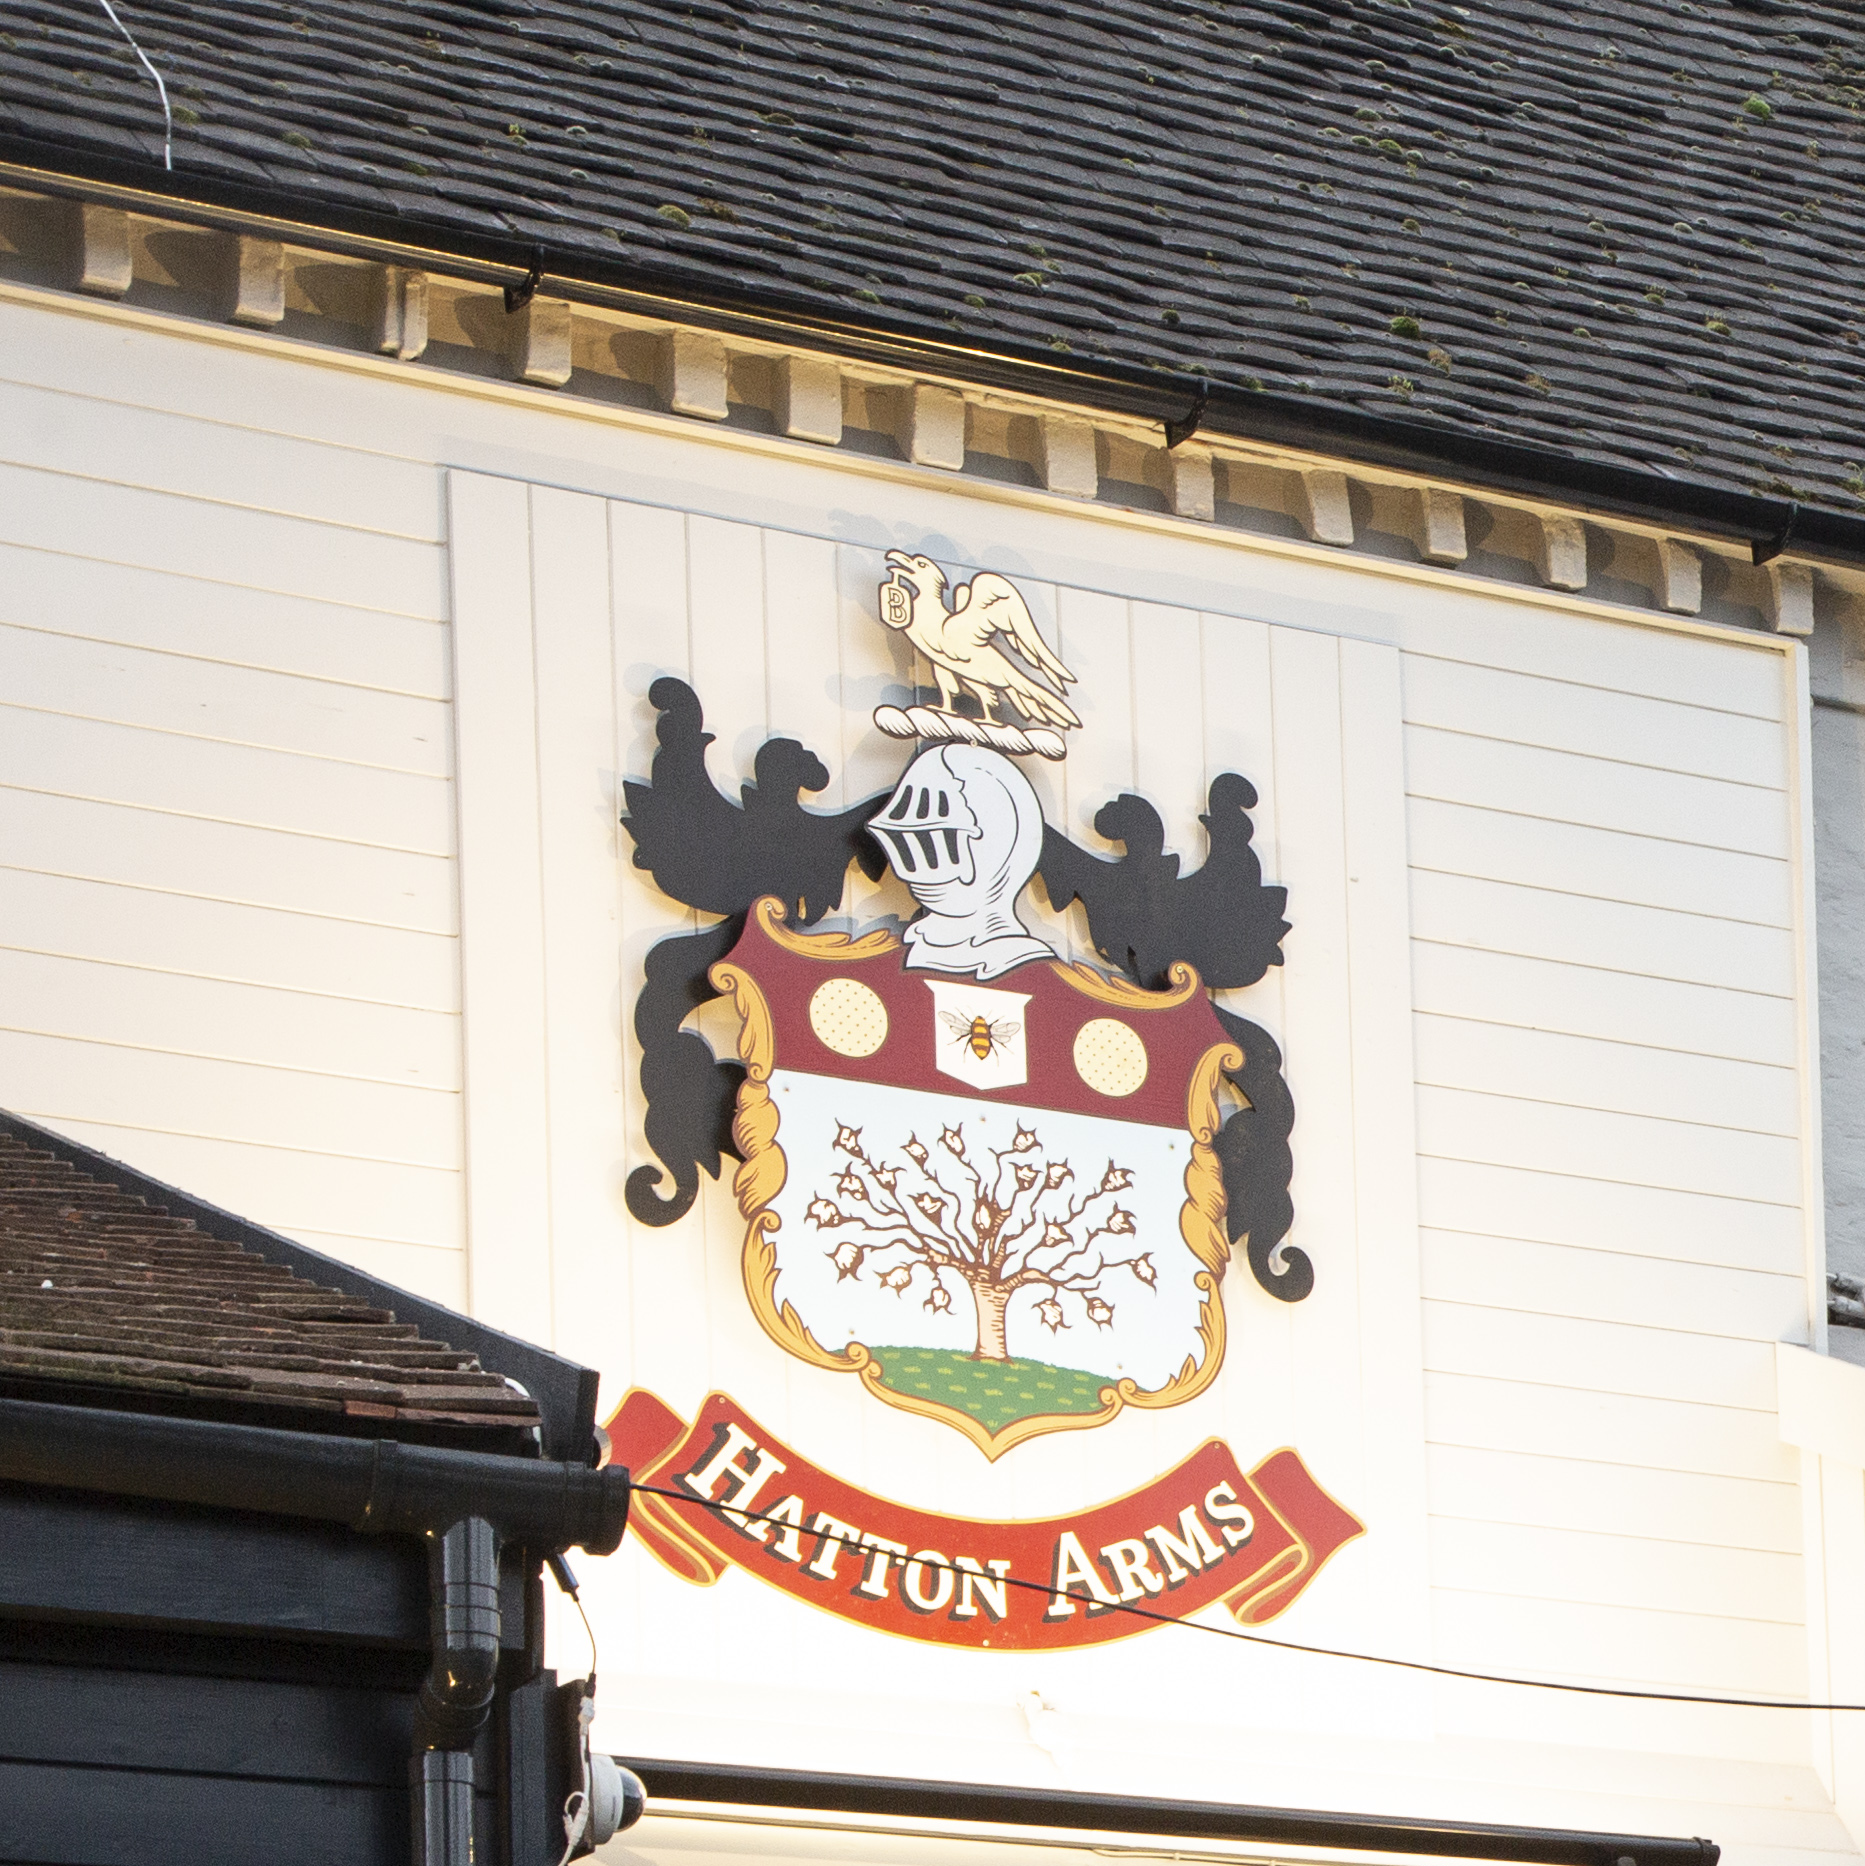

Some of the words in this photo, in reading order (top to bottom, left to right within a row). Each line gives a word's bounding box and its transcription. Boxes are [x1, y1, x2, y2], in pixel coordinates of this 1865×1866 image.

[887, 586, 908, 624] B
[685, 1421, 1011, 1620] HATTON
[1046, 1479, 1257, 1617] ARMS
